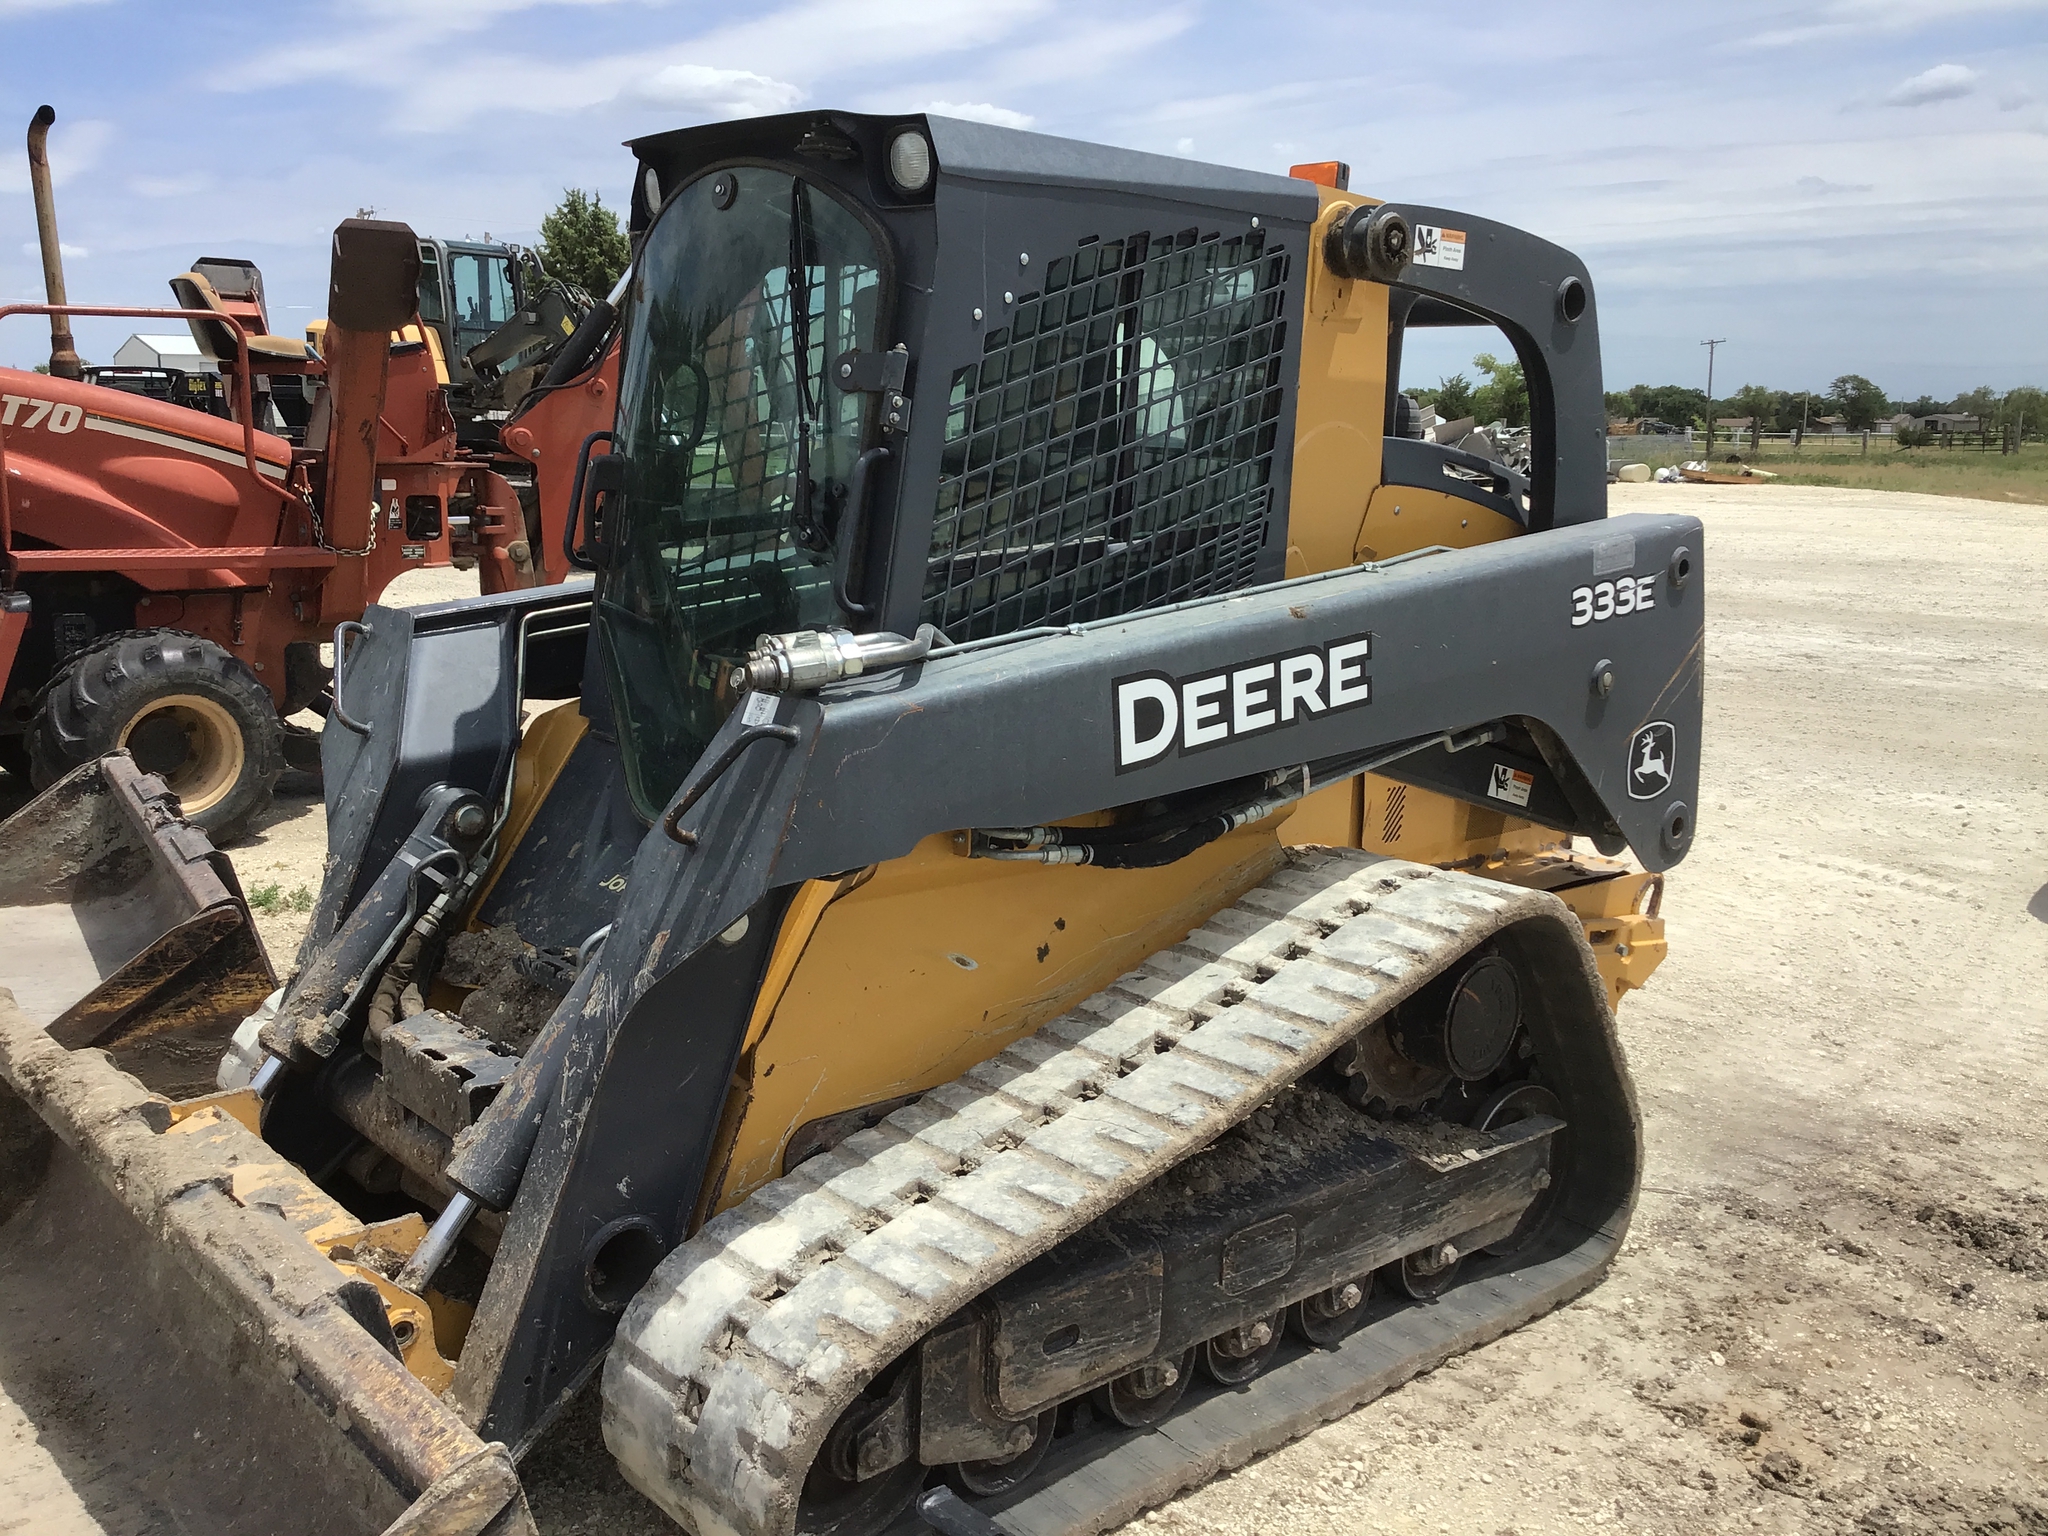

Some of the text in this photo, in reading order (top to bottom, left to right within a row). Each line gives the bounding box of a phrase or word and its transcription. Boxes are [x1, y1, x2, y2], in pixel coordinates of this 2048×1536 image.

[1, 393, 83, 435] T70
[1571, 575, 1656, 626] 333E
[1118, 639, 1368, 766] DEERE
